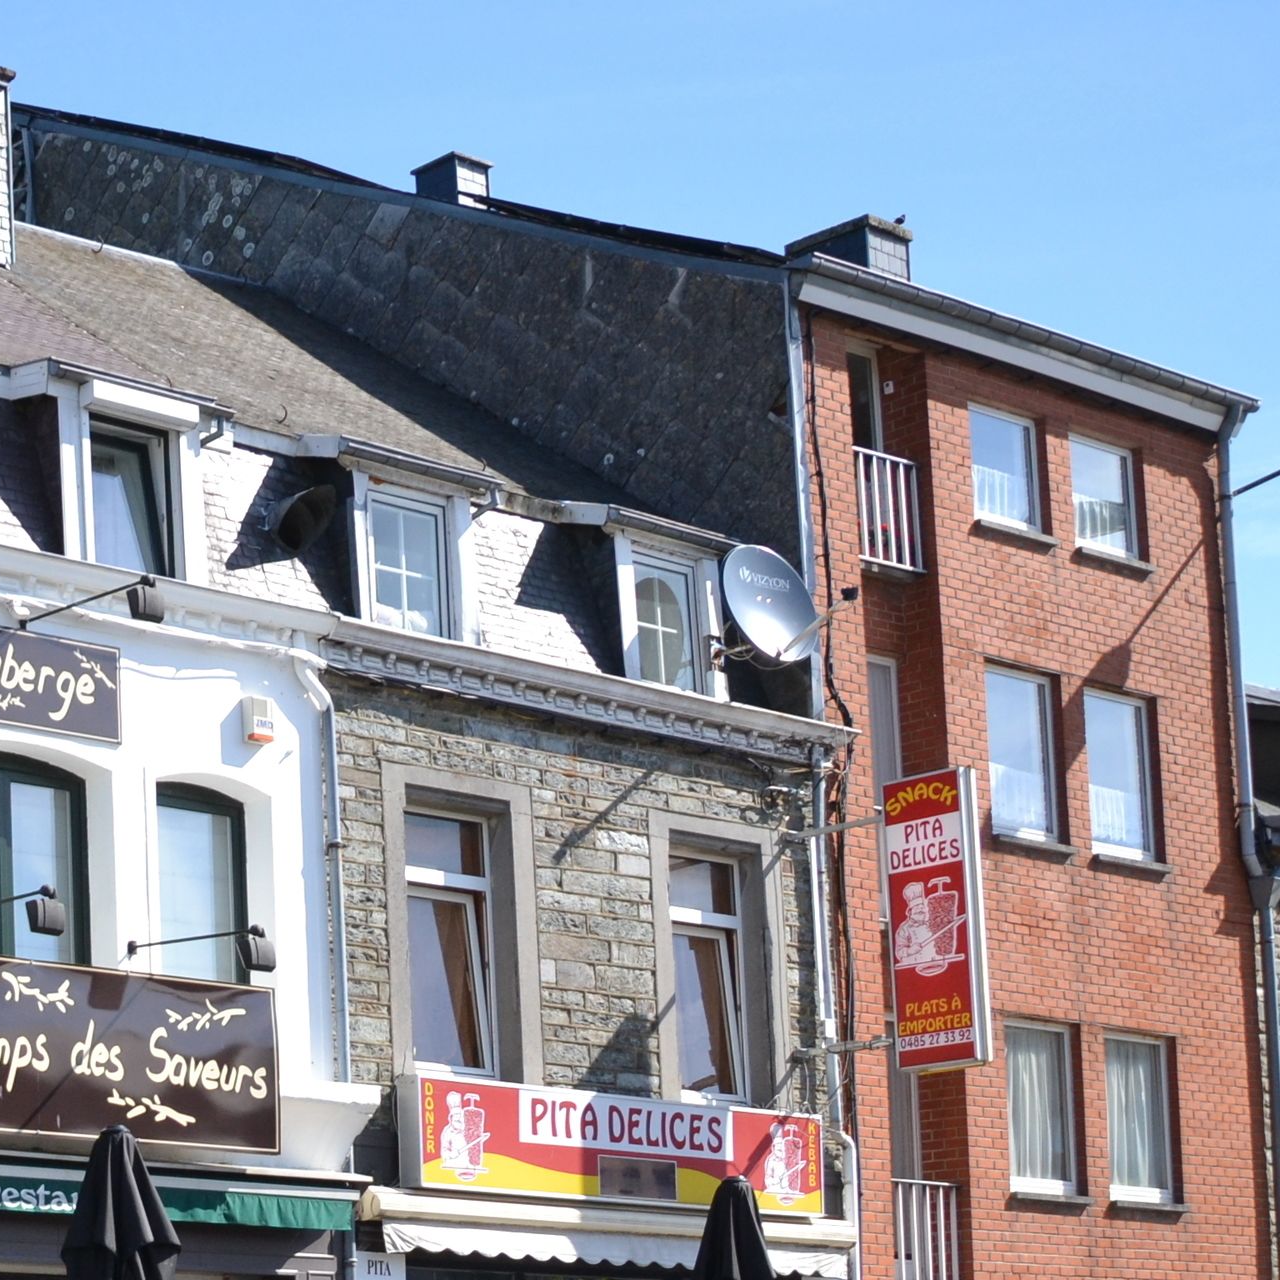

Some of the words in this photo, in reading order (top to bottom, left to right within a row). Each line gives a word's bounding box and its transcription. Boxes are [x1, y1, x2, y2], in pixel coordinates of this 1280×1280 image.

[886, 782, 958, 816] SNACK
[904, 818, 943, 844] PITA
[890, 838, 960, 870] DELICES
[906, 998, 948, 1017] PLATS
[898, 1012, 972, 1036] EMPORTER
[900, 1035, 926, 1049] 0485
[943, 1031, 956, 1043] 33
[958, 1029, 971, 1041] 92
[70, 1019, 125, 1081] des
[146, 1026, 268, 1099] Saveurs
[424, 1082, 436, 1153] DONER
[530, 1097, 598, 1140] PITA
[608, 1105, 723, 1153] DELICES
[808, 1122, 817, 1187] KEBAB
[367, 1259, 391, 1276] PITA
